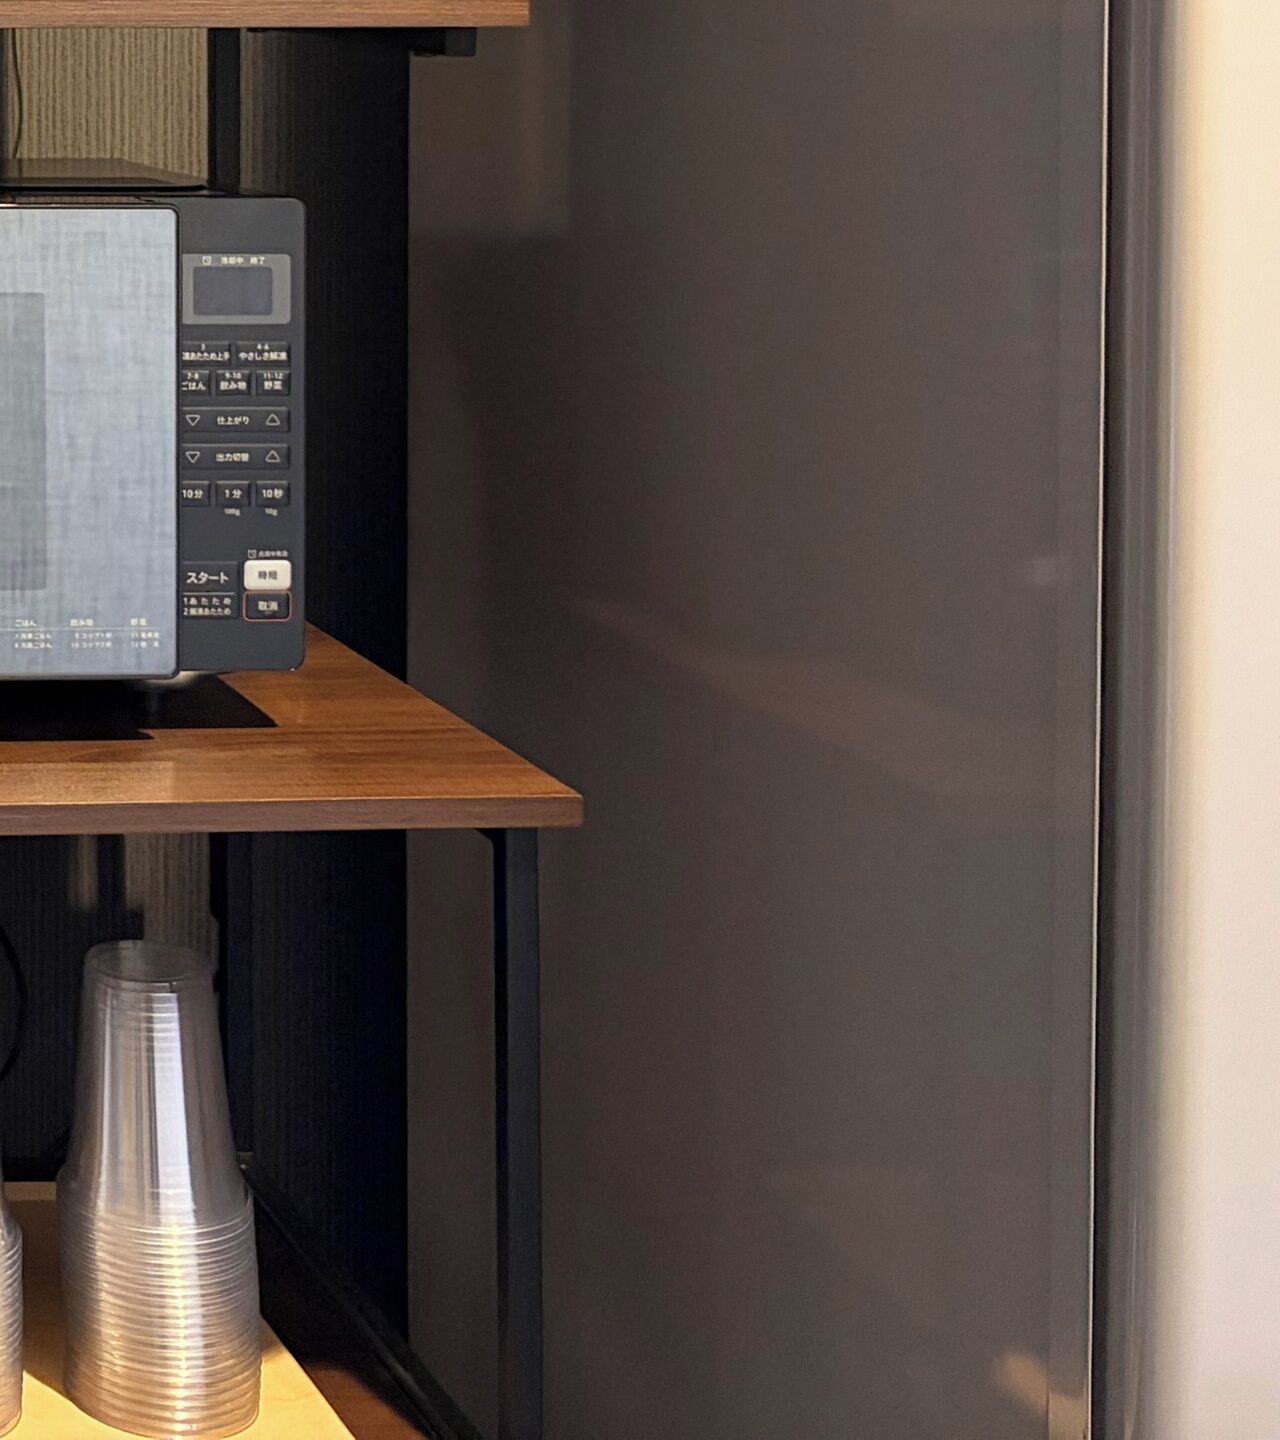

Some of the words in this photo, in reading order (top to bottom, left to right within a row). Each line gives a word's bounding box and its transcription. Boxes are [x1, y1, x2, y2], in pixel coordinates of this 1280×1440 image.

[216, 416, 250, 425] 仕上がり
[182, 489, 204, 498] 10分
[262, 489, 284, 498] 10秒
[186, 572, 229, 584] スタート
